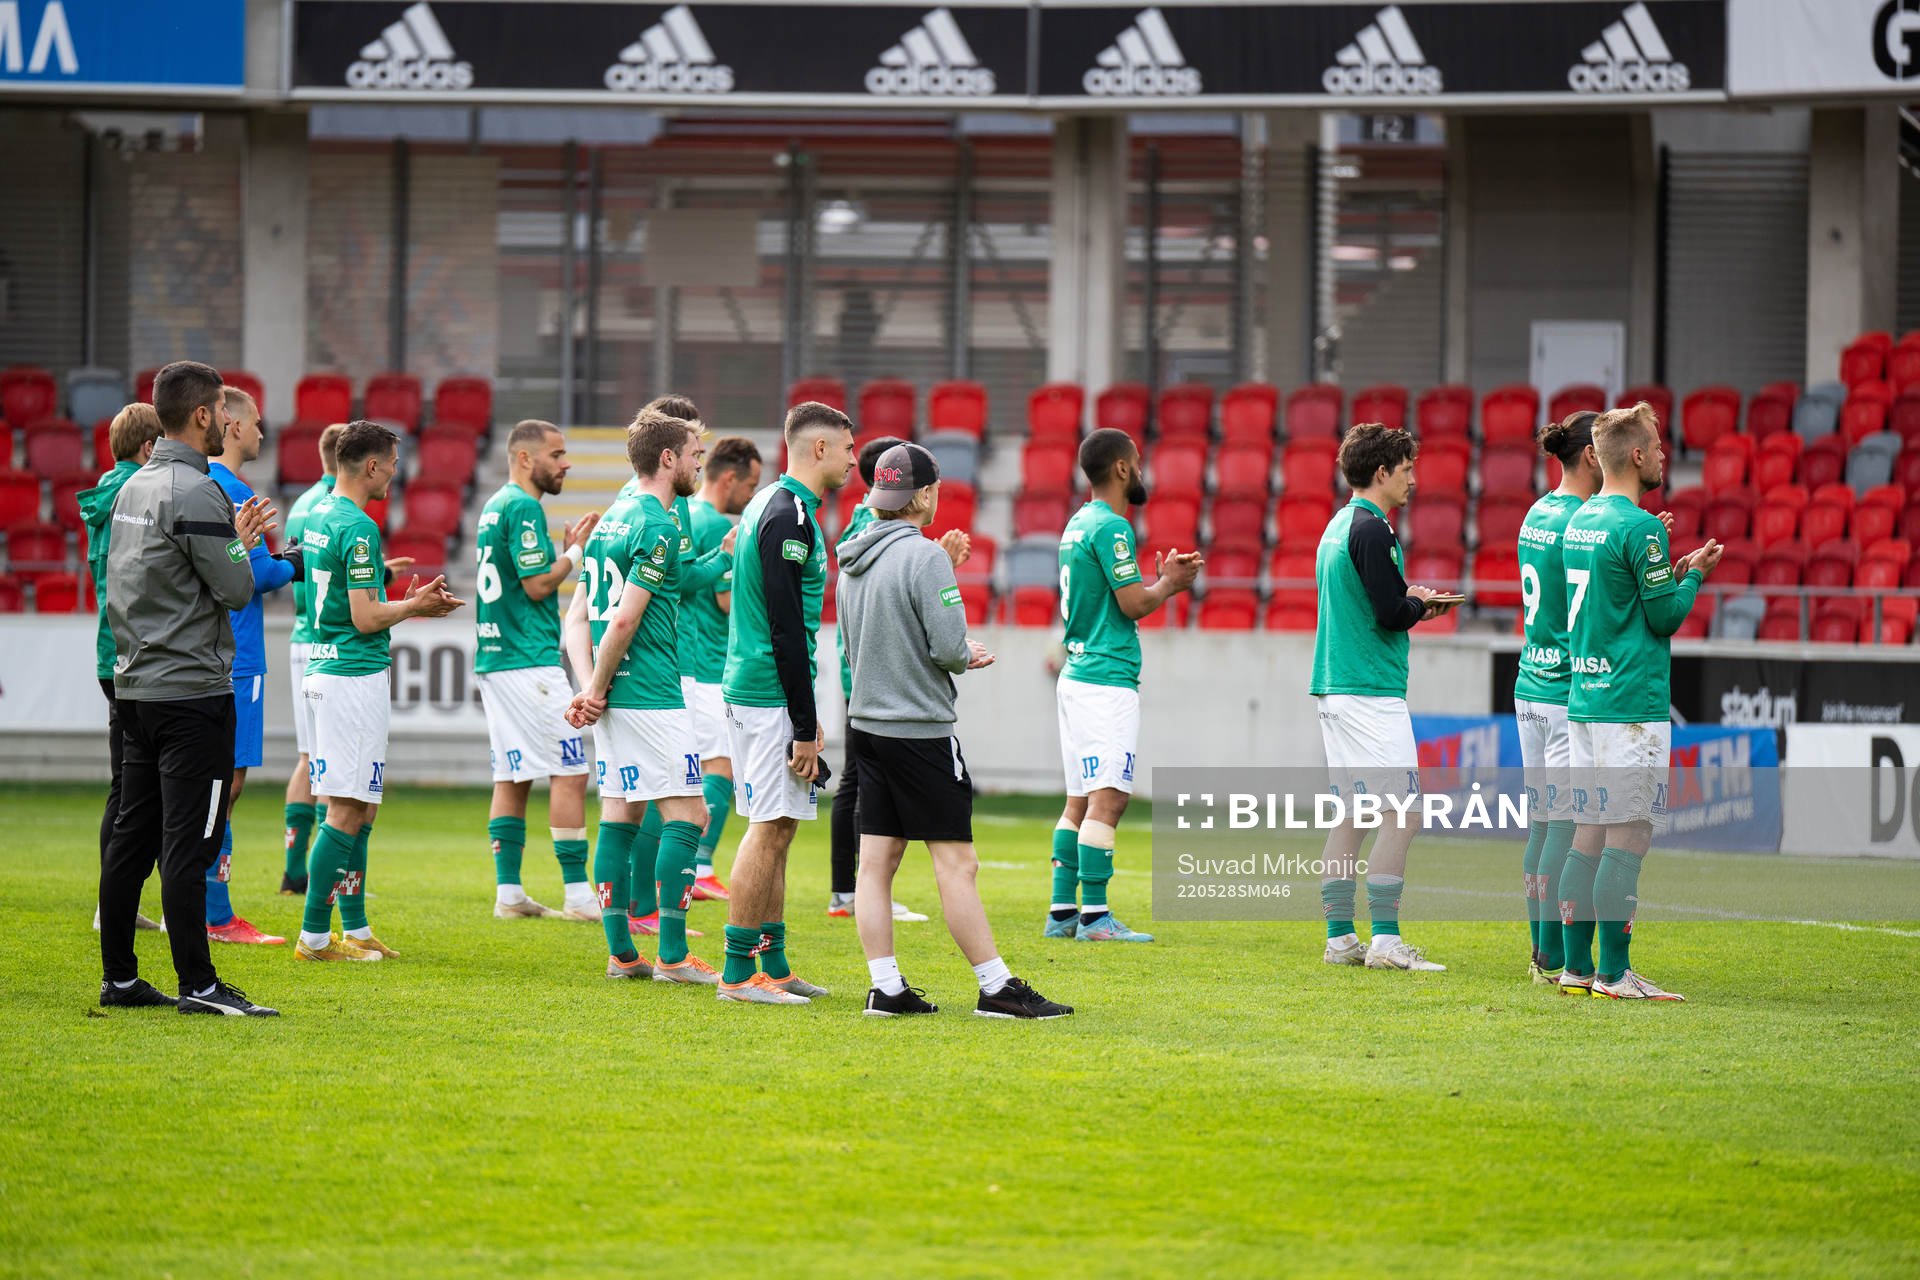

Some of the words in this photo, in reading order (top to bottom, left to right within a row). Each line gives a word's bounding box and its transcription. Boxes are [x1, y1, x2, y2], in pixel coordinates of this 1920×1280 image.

[346, 60, 474, 89] adidas
[604, 63, 734, 92] adidas
[864, 66, 996, 95] adidas
[1083, 66, 1202, 95] adidas
[1322, 64, 1443, 94] adidas
[1567, 62, 1690, 92] adidas
[350, 567, 374, 576] UNIBET
[640, 565, 664, 580] UNIBET
[1646, 566, 1671, 580] UNIBET
[311, 567, 332, 630] 7
[584, 556, 624, 621] 22
[1521, 563, 1541, 626] 9
[1567, 568, 1590, 633] 7
[1720, 685, 1798, 727] stadium
[1082, 756, 1099, 779] JP
